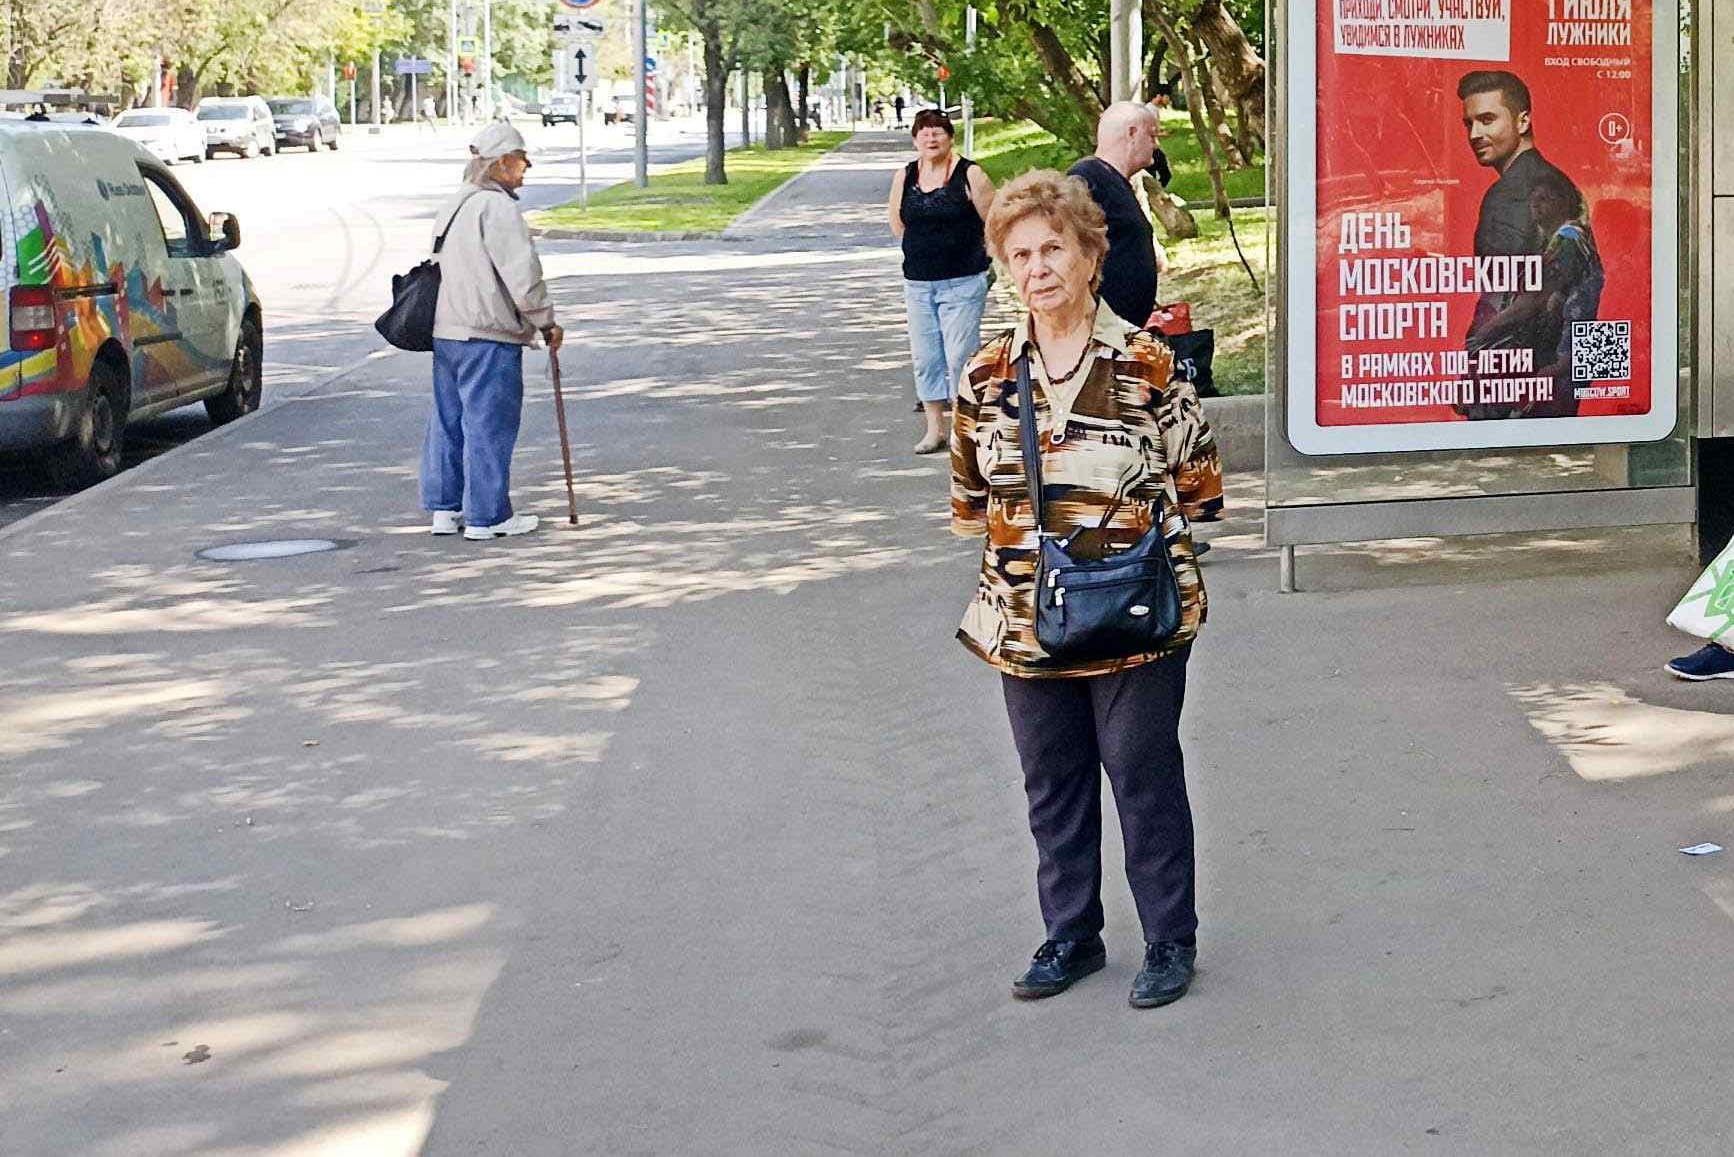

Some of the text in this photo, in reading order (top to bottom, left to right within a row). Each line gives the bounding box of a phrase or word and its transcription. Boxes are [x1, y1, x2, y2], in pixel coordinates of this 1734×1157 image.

[1340, 25, 1465, 50] УВИДИМСЯ В ЛУЖНИКАХ
[1547, 22, 1632, 46] ЛУЖНИКИ
[1544, 56, 1631, 67] ВХОД СВОБОДНЫЙ
[1608, 120, 1623, 137] 0+
[1338, 212, 1411, 255] ДЕНЬ
[1338, 254, 1543, 297] МОСКОВСКОГО
[1338, 301, 1448, 342] СПОРТА
[1341, 348, 1533, 379] В РАМКАХ 100-ЛЕТИЯ
[1341, 377, 1554, 409] МОСКОВСКОГО СПОРТА!
